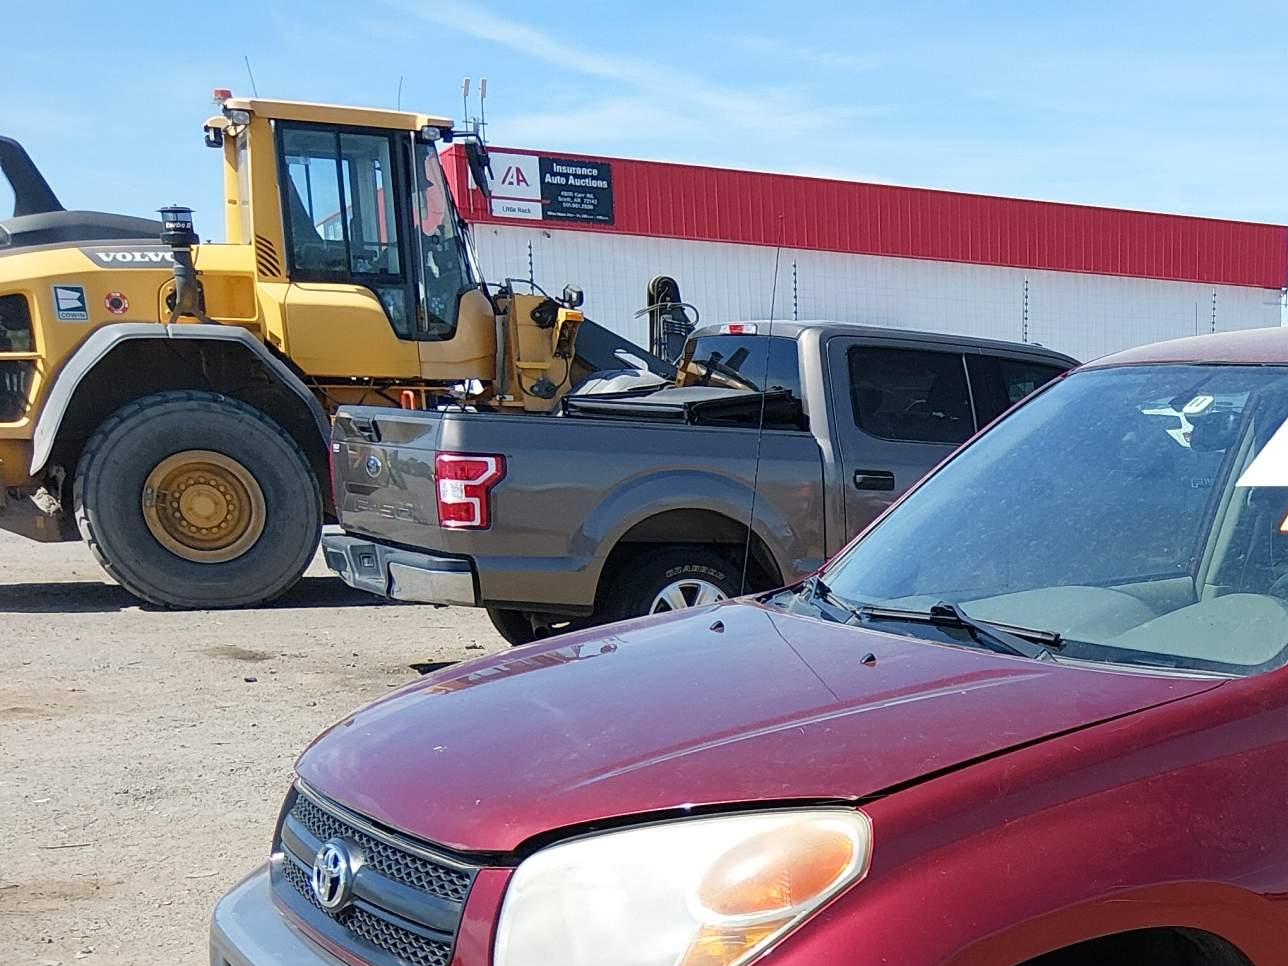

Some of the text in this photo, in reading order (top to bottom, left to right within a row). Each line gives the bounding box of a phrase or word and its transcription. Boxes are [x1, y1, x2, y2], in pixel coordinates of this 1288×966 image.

[553, 162, 598, 176] Insurance
[544, 173, 608, 189] Auto Auctions
